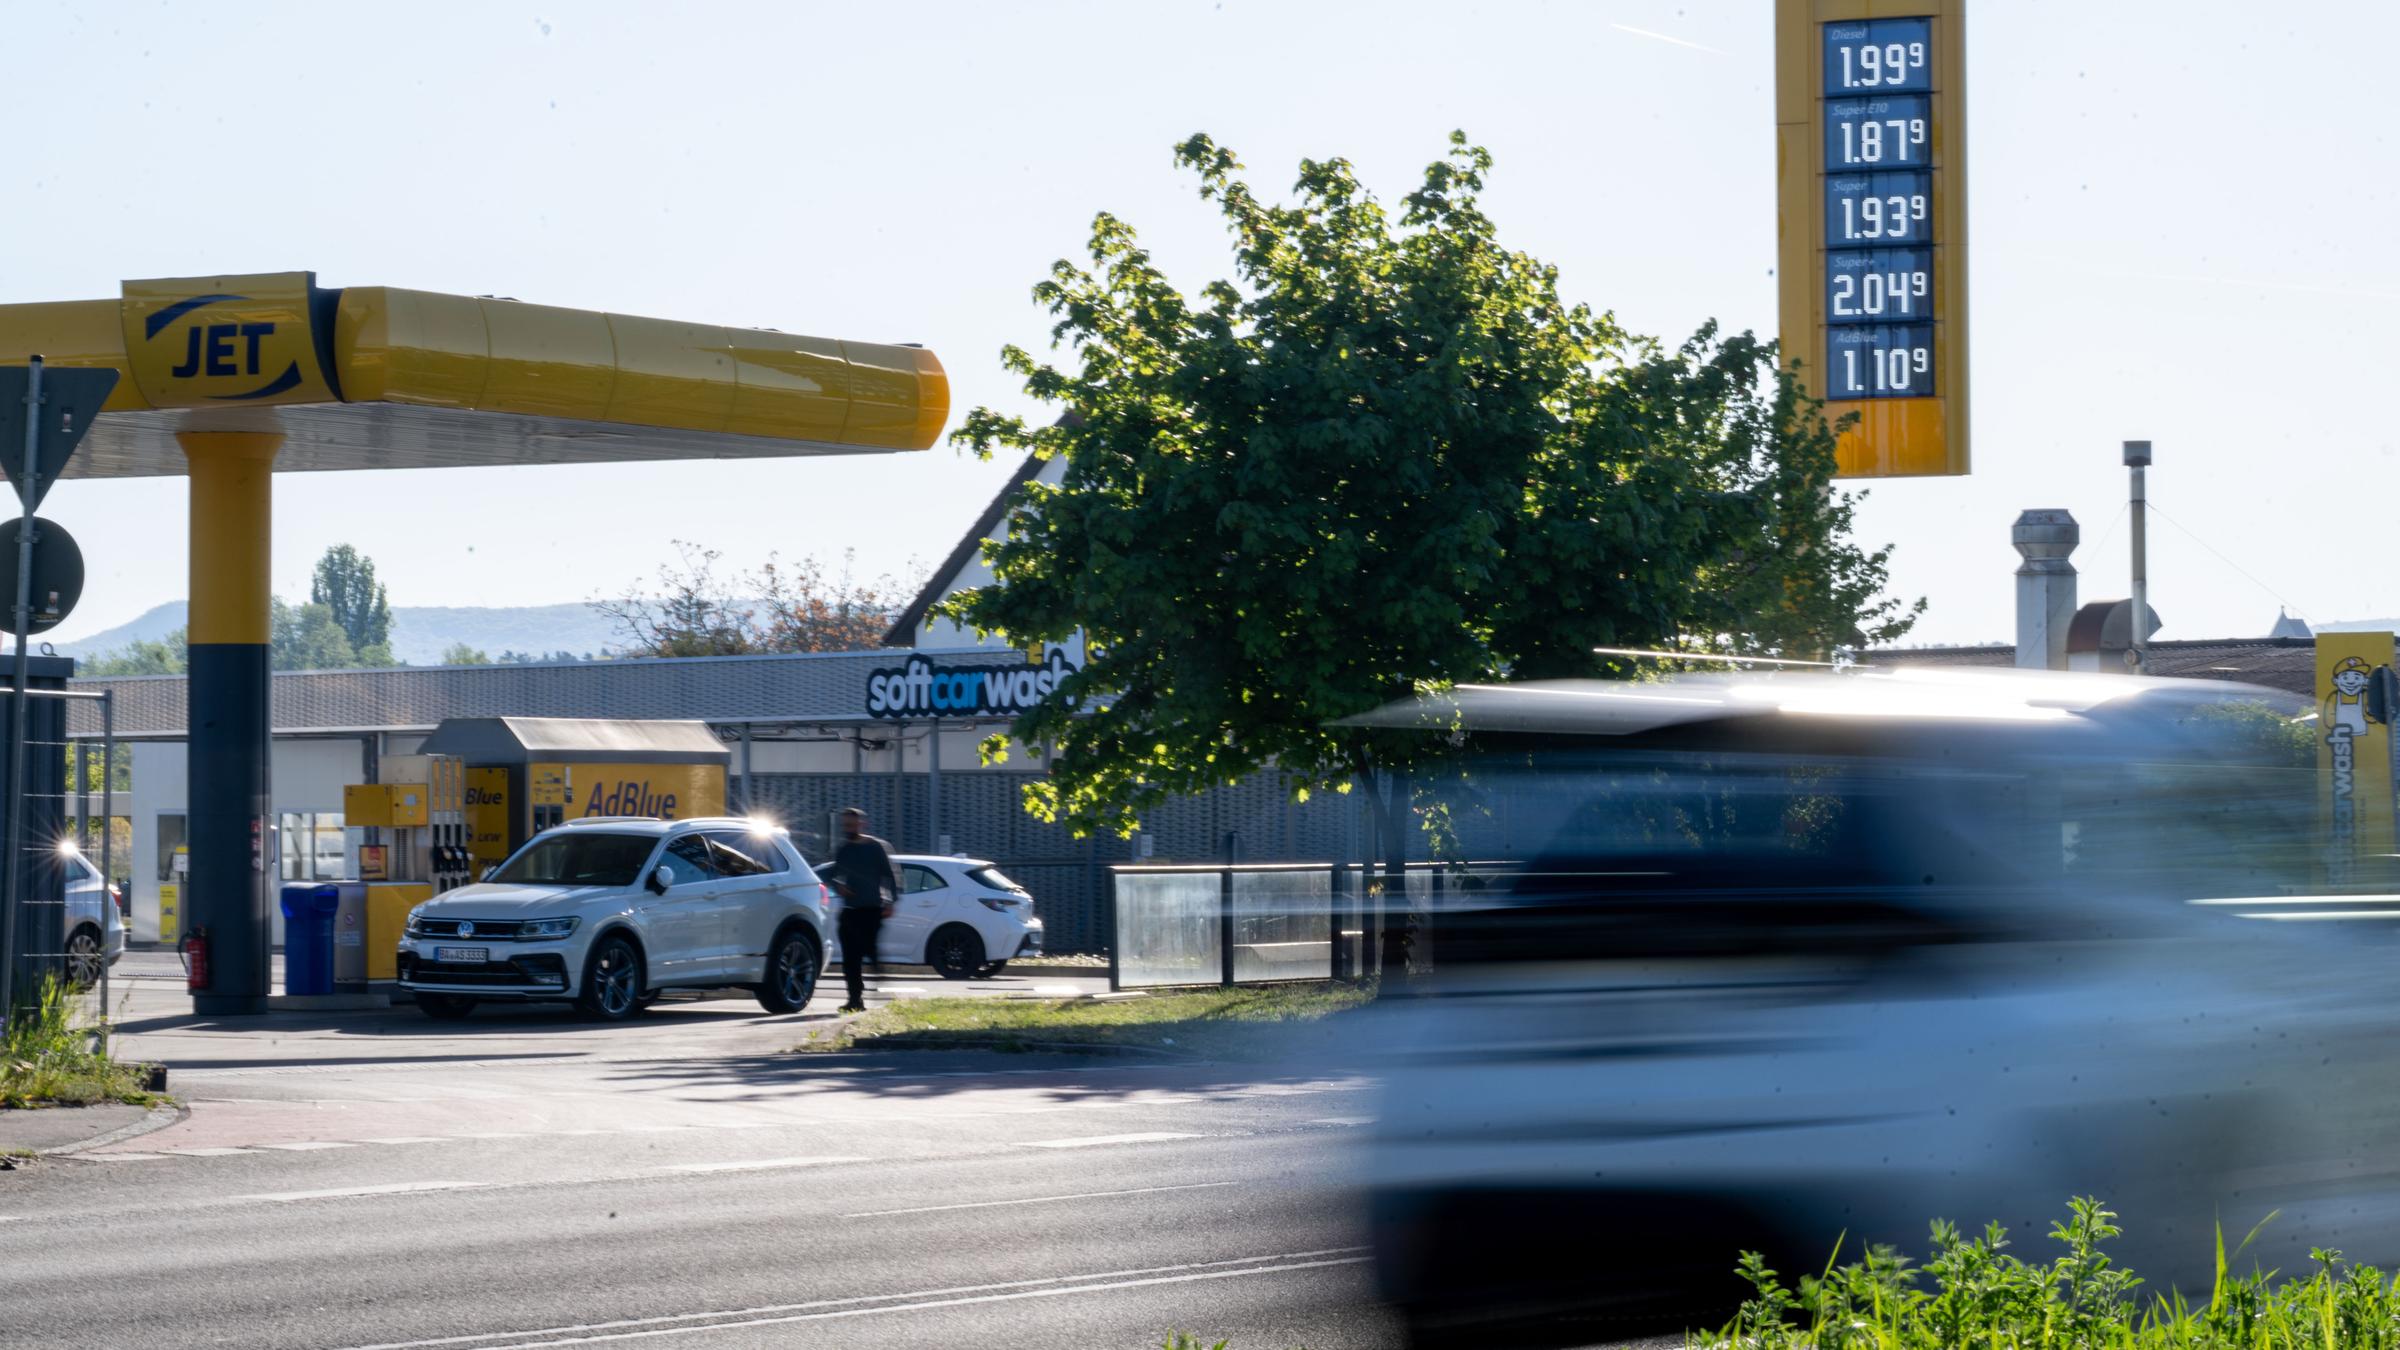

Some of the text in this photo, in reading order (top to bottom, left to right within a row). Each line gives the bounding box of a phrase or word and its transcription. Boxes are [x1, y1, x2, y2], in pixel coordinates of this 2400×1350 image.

[1832, 27, 1866, 40] Diesel
[1840, 42, 1925, 88] 1.999
[1832, 102, 1888, 118] Super E10
[1841, 118, 1925, 163] 1.879
[1833, 181, 1867, 193] Super
[1841, 195, 1926, 239] 1.939
[1834, 257, 1875, 269] Super+
[1833, 271, 1927, 315] 2.049
[172, 322, 275, 378] JET
[1836, 332, 1878, 343] AdBlue
[1844, 348, 1928, 391] 1.109
[869, 656, 1074, 711] softcarwash
[465, 787, 502, 805] Blue
[584, 780, 677, 818] AdBlue
[2326, 726, 2353, 880] carwash
